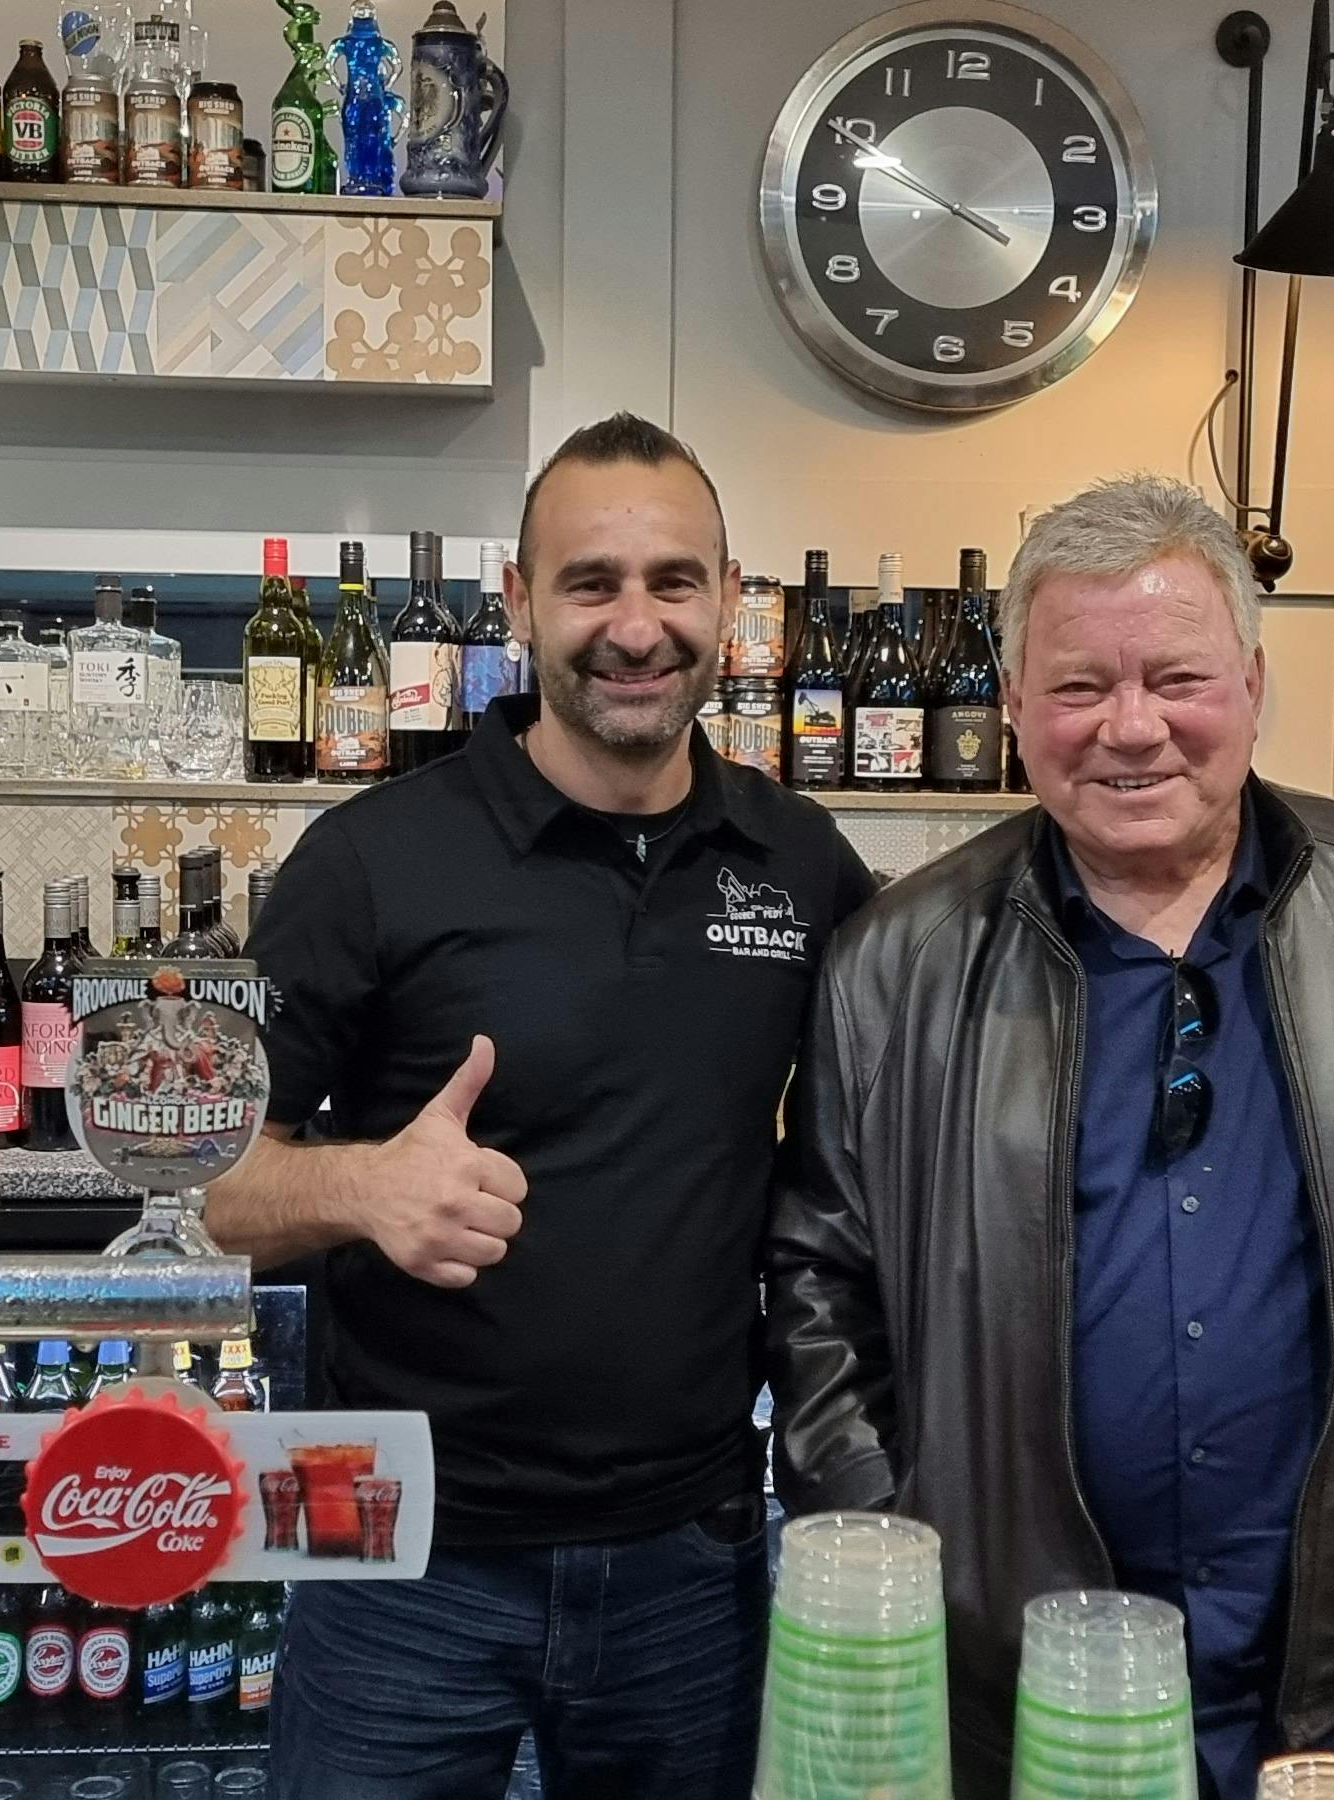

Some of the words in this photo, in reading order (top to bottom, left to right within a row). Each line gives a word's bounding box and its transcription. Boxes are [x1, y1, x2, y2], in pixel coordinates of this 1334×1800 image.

[946, 50, 991, 80] 12
[885, 67, 910, 97] 11
[1034, 78, 1044, 106] 1
[7, 100, 51, 120] VICTORIA
[14, 121, 43, 139] VB
[833, 116, 877, 145] 10
[9, 148, 50, 160] BITTER
[1062, 135, 1096, 163] 2
[811, 183, 847, 210] 9
[1072, 205, 1107, 232] 3
[825, 255, 860, 283] 8
[1049, 275, 1081, 303] 4
[866, 308, 899, 335] 7
[1001, 320, 1035, 348] 5
[933, 335, 965, 363] 6
[79, 662, 111, 672] TOKI
[706, 924, 807, 952] OUTBACK
[732, 946, 751, 956] BAR
[752, 948, 770, 958] AND
[770, 949, 792, 961] GRILL
[72, 978, 149, 1022] BROOKVALE
[189, 980, 266, 1026] UNION
[92, 1100, 180, 1135] GINGER
[183, 1100, 246, 1134] BEER
[95, 1464, 132, 1481] Enjoy
[42, 1471, 231, 1533] Coca-Cola
[157, 1529, 204, 1553] Coke
[189, 1640, 234, 1667] HAHN
